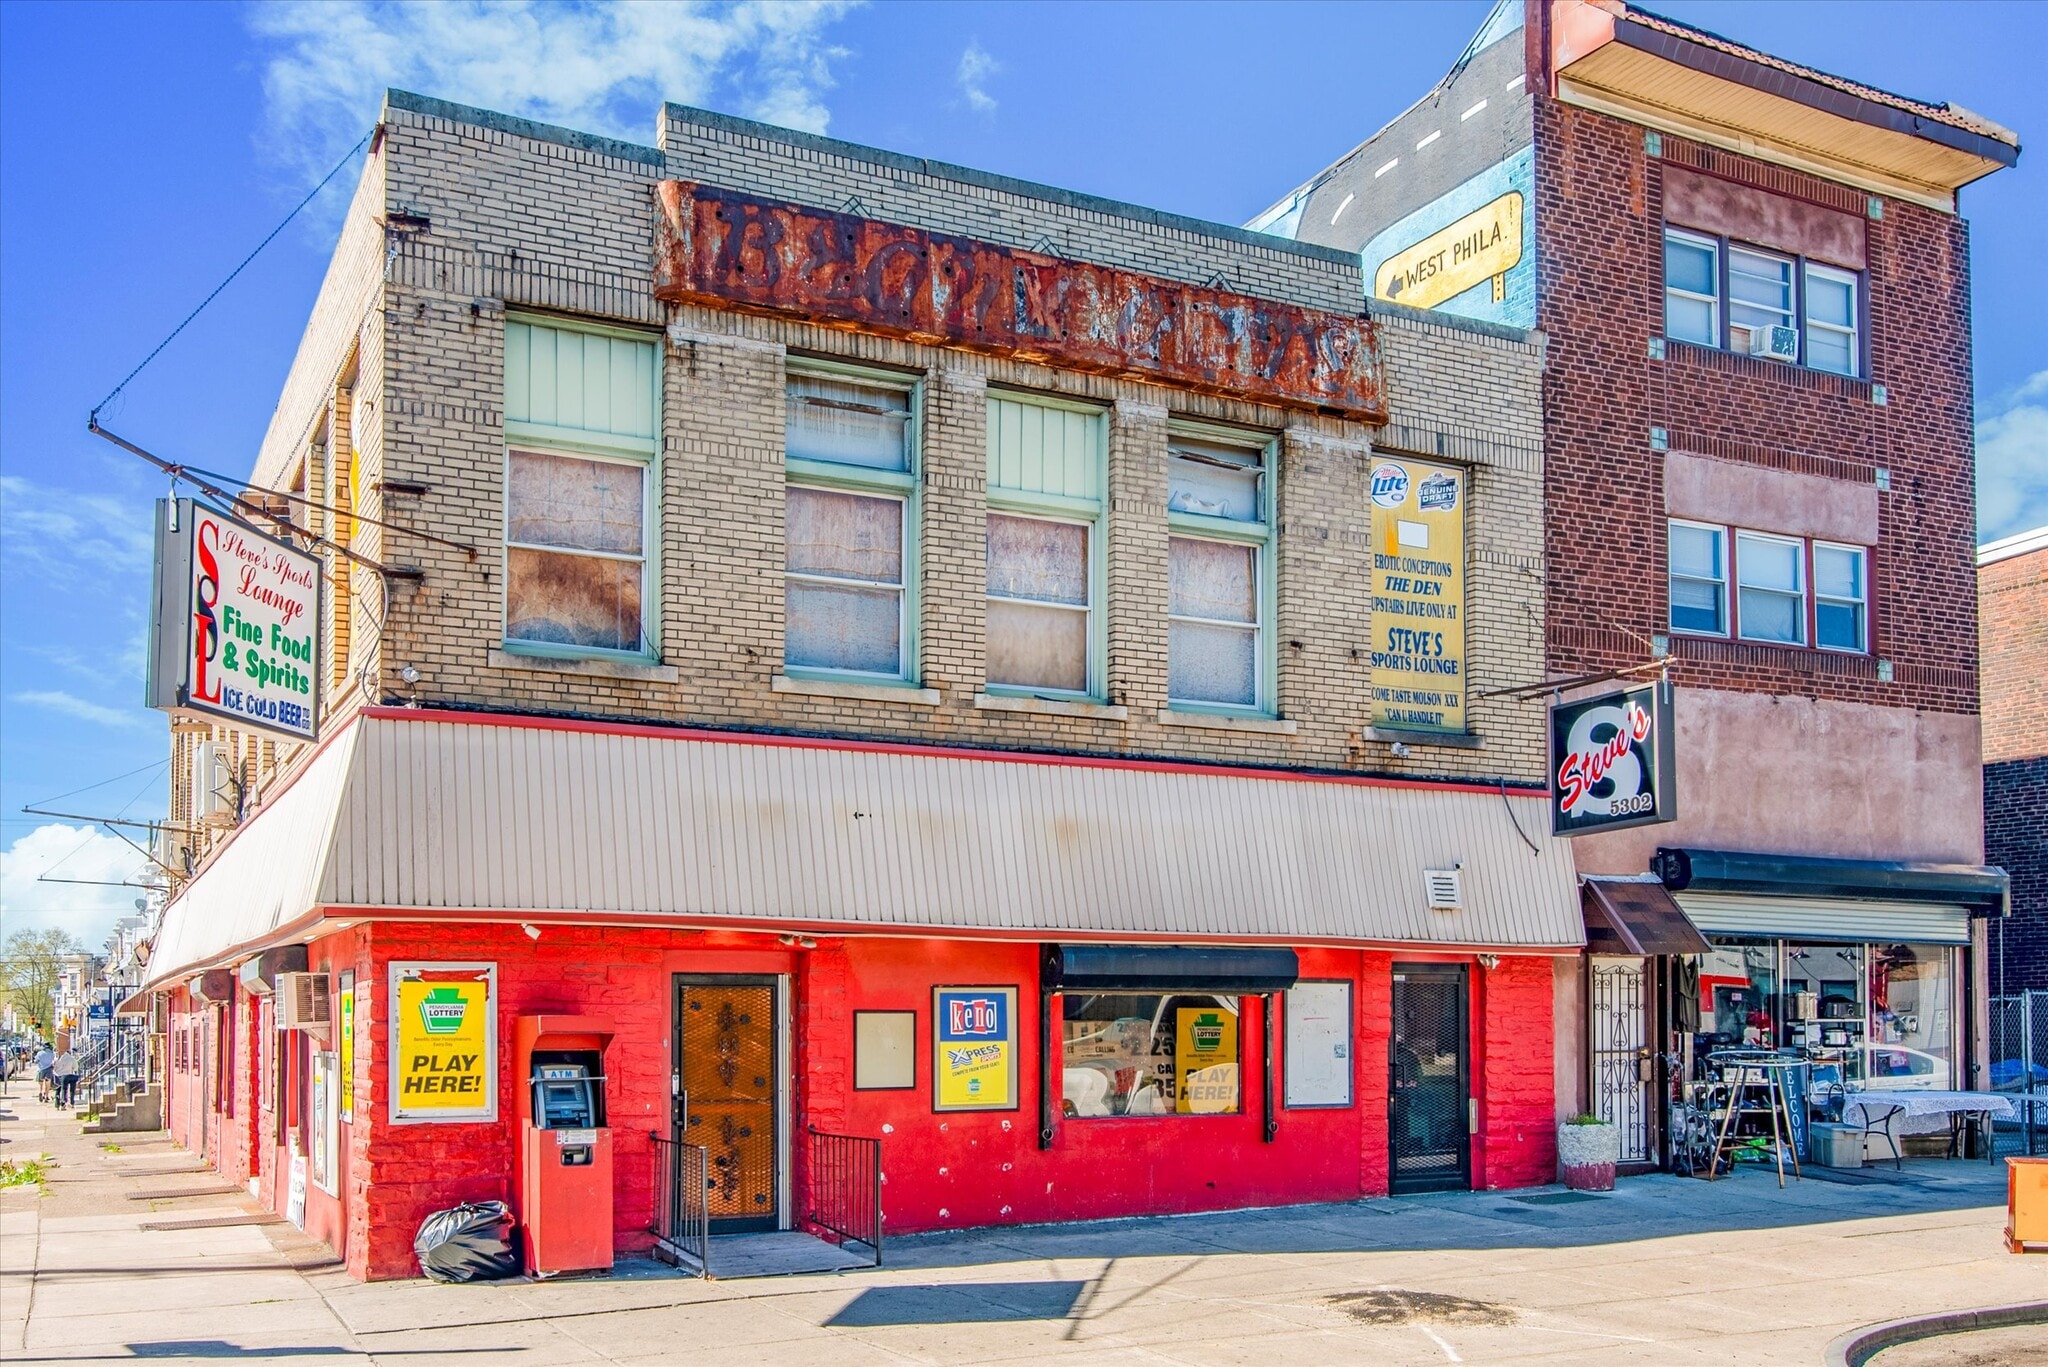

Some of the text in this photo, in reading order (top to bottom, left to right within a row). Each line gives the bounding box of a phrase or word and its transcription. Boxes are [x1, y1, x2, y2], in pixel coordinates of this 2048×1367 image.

[1406, 221, 1508, 288] WEST PHILA.
[1372, 476, 1407, 496] Lite
[1418, 485, 1458, 496] GENUINE
[1422, 493, 1453, 502] DRAFT
[222, 530, 313, 590] Steve's Sports
[1374, 554, 1452, 577] EROTIC CONCEPTIONS
[237, 564, 304, 626] Lounge
[1385, 576, 1442, 596] THE DEN
[1371, 596, 1457, 619] UPSTAIRS LIVE ONLY AT
[223, 605, 311, 664] Fine Food
[1388, 627, 1443, 656] STEVE'S
[223, 641, 309, 695] & Spirits
[1371, 652, 1458, 674] SPORTS LOUNGE
[223, 686, 301, 728] ICE COLD BEER
[1371, 687, 1458, 707] COME TASTE MOLSON XXX
[1402, 710, 1407, 721] U
[1408, 710, 1434, 724] HANDLE
[1559, 708, 1650, 811] Steve's
[1610, 795, 1652, 815] 5302
[412, 1055, 478, 1072] PLAY
[949, 1045, 1001, 1068] XPRESS
[404, 1076, 481, 1093] HERE!
[551, 1070, 572, 1078] ATM
[1185, 1069, 1230, 1083] PLAY
[1180, 1086, 1232, 1100] HERE!
